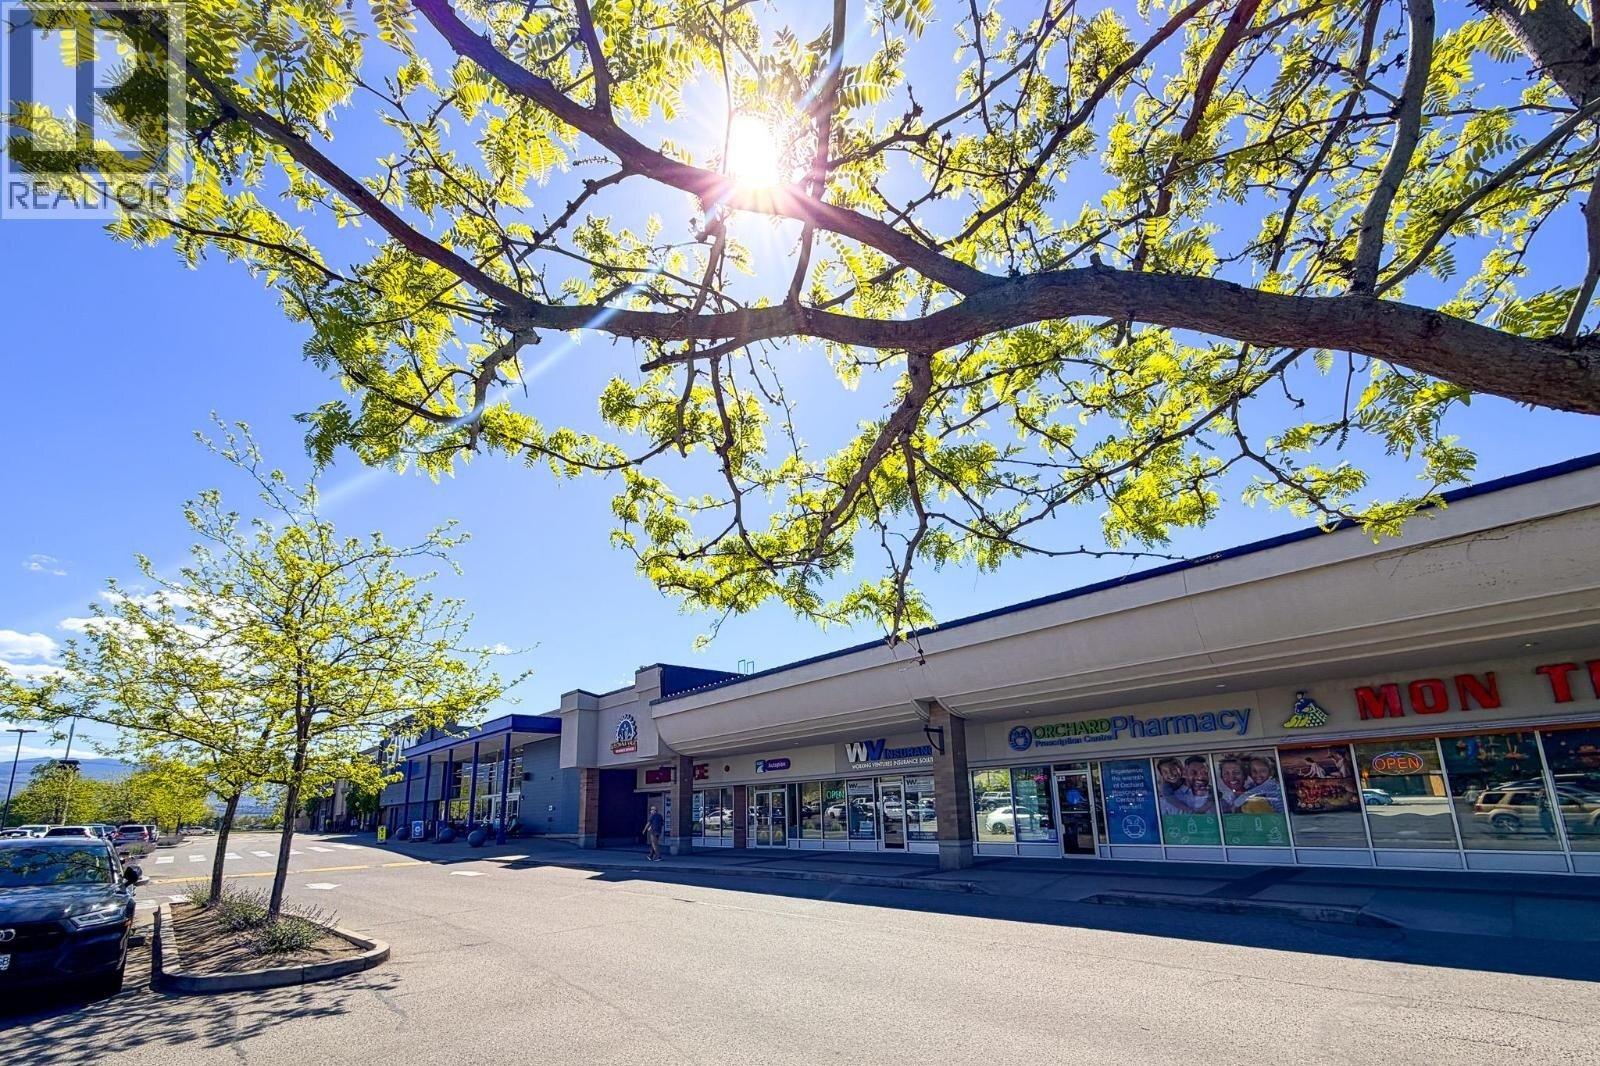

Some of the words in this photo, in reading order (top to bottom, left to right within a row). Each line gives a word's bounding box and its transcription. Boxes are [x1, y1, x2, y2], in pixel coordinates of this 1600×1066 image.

[1354, 671, 1501, 720] MON
[1033, 718, 1111, 739] ORCHARD
[1110, 708, 1251, 740] Pharmacy
[845, 739, 885, 762] WV
[1374, 757, 1420, 770] OPEN
